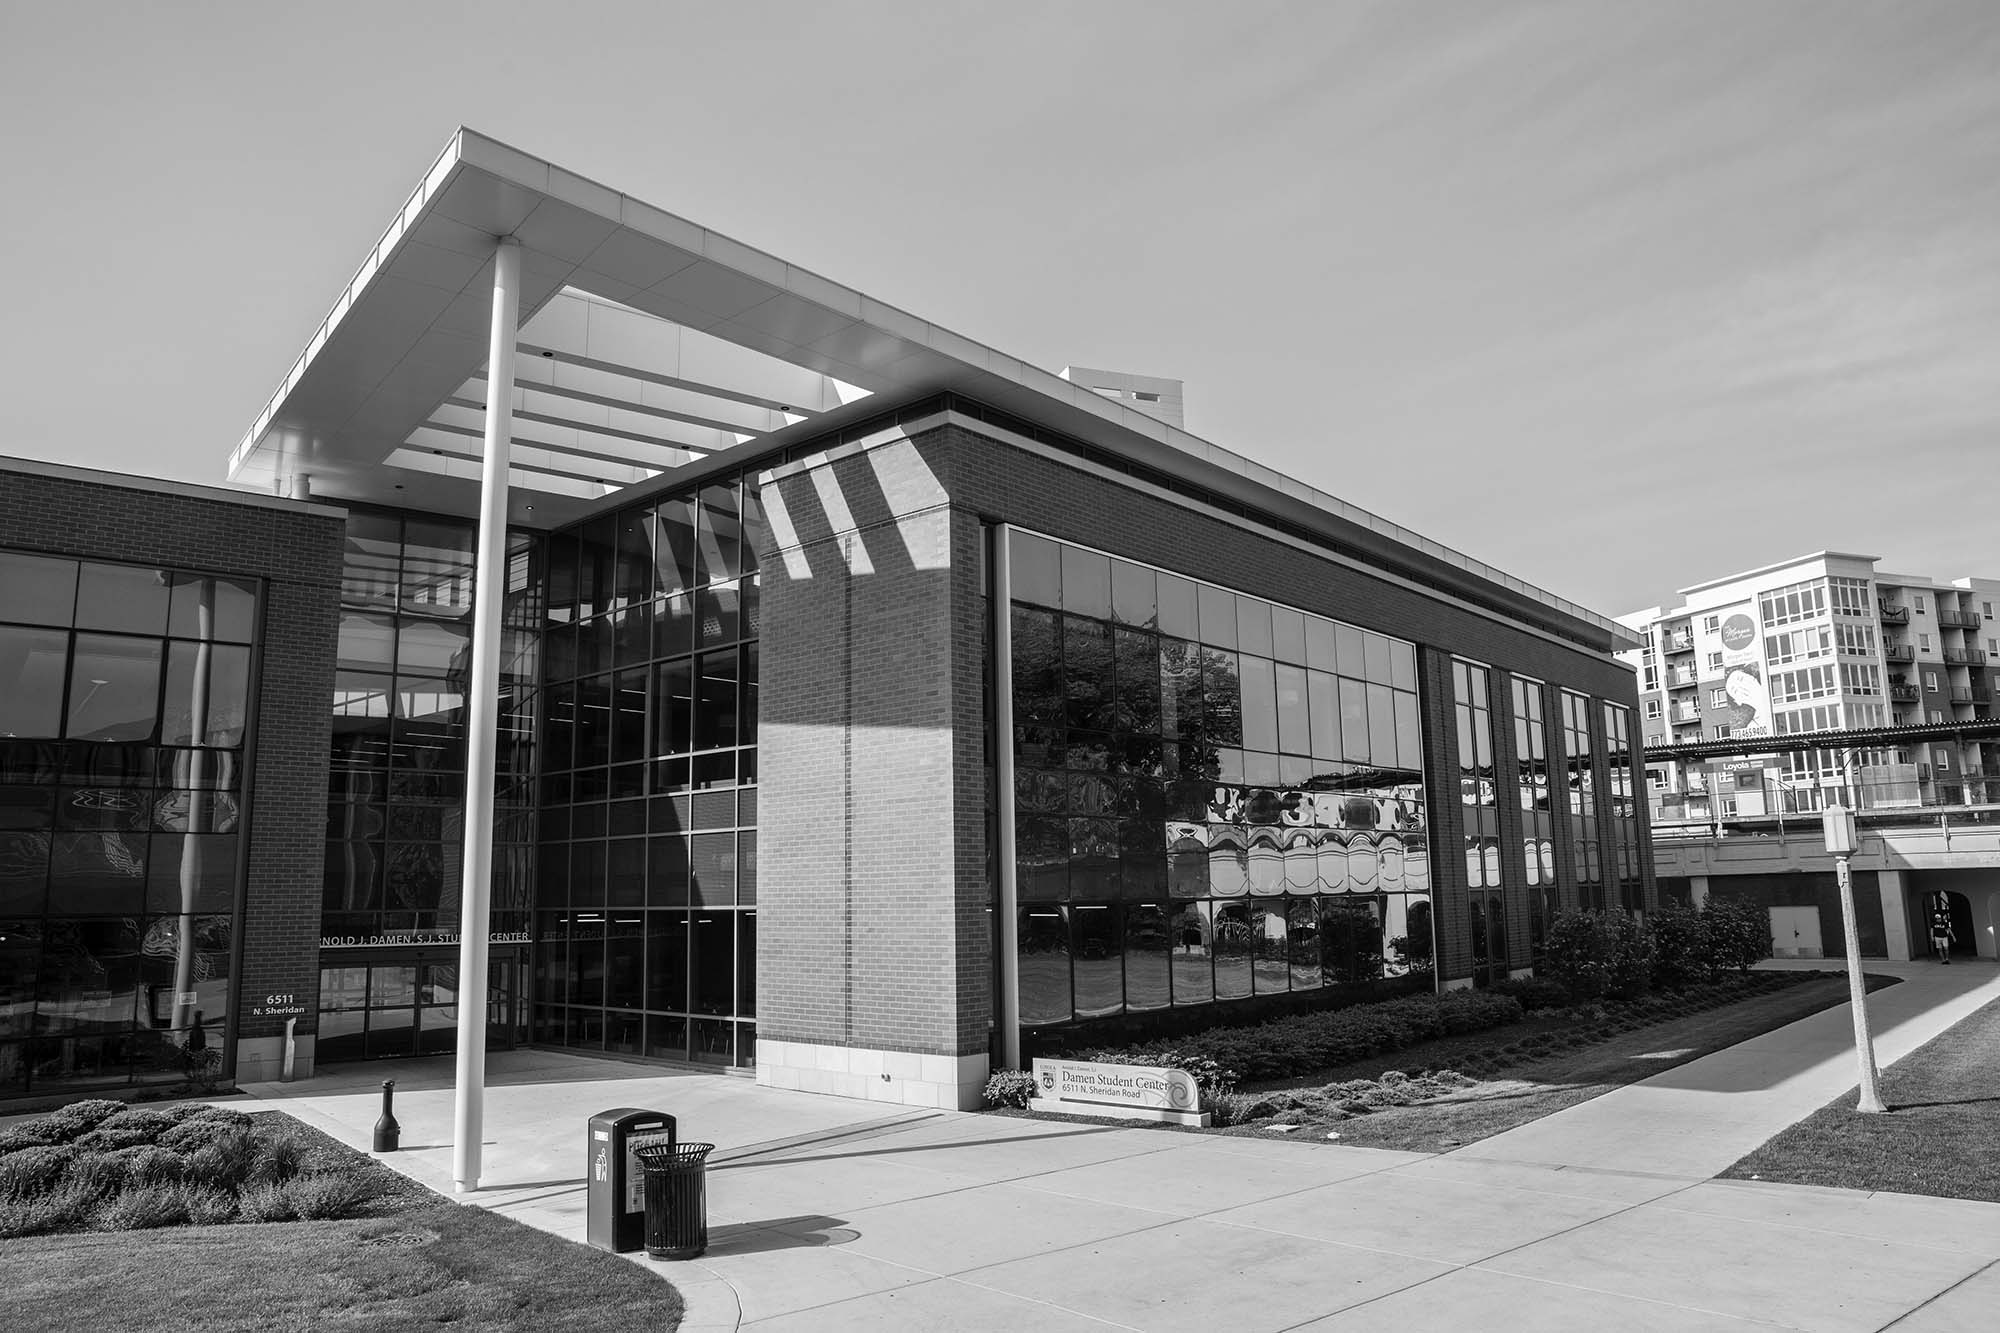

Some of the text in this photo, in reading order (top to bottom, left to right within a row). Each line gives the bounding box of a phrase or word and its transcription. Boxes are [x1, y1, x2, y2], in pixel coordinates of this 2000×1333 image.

[1723, 761, 1749, 771] Loyola
[320, 936, 355, 946] NOLD
[360, 936, 367, 945] J.
[438, 933, 461, 943] STU
[489, 932, 529, 942] CENTER
[266, 994, 294, 1005] 6511
[253, 1006, 305, 1015] N. Sheridan
[1062, 1070, 1169, 1090] Damen Student Center
[1062, 1083, 1141, 1098] 6511 N. Sheridan Road
